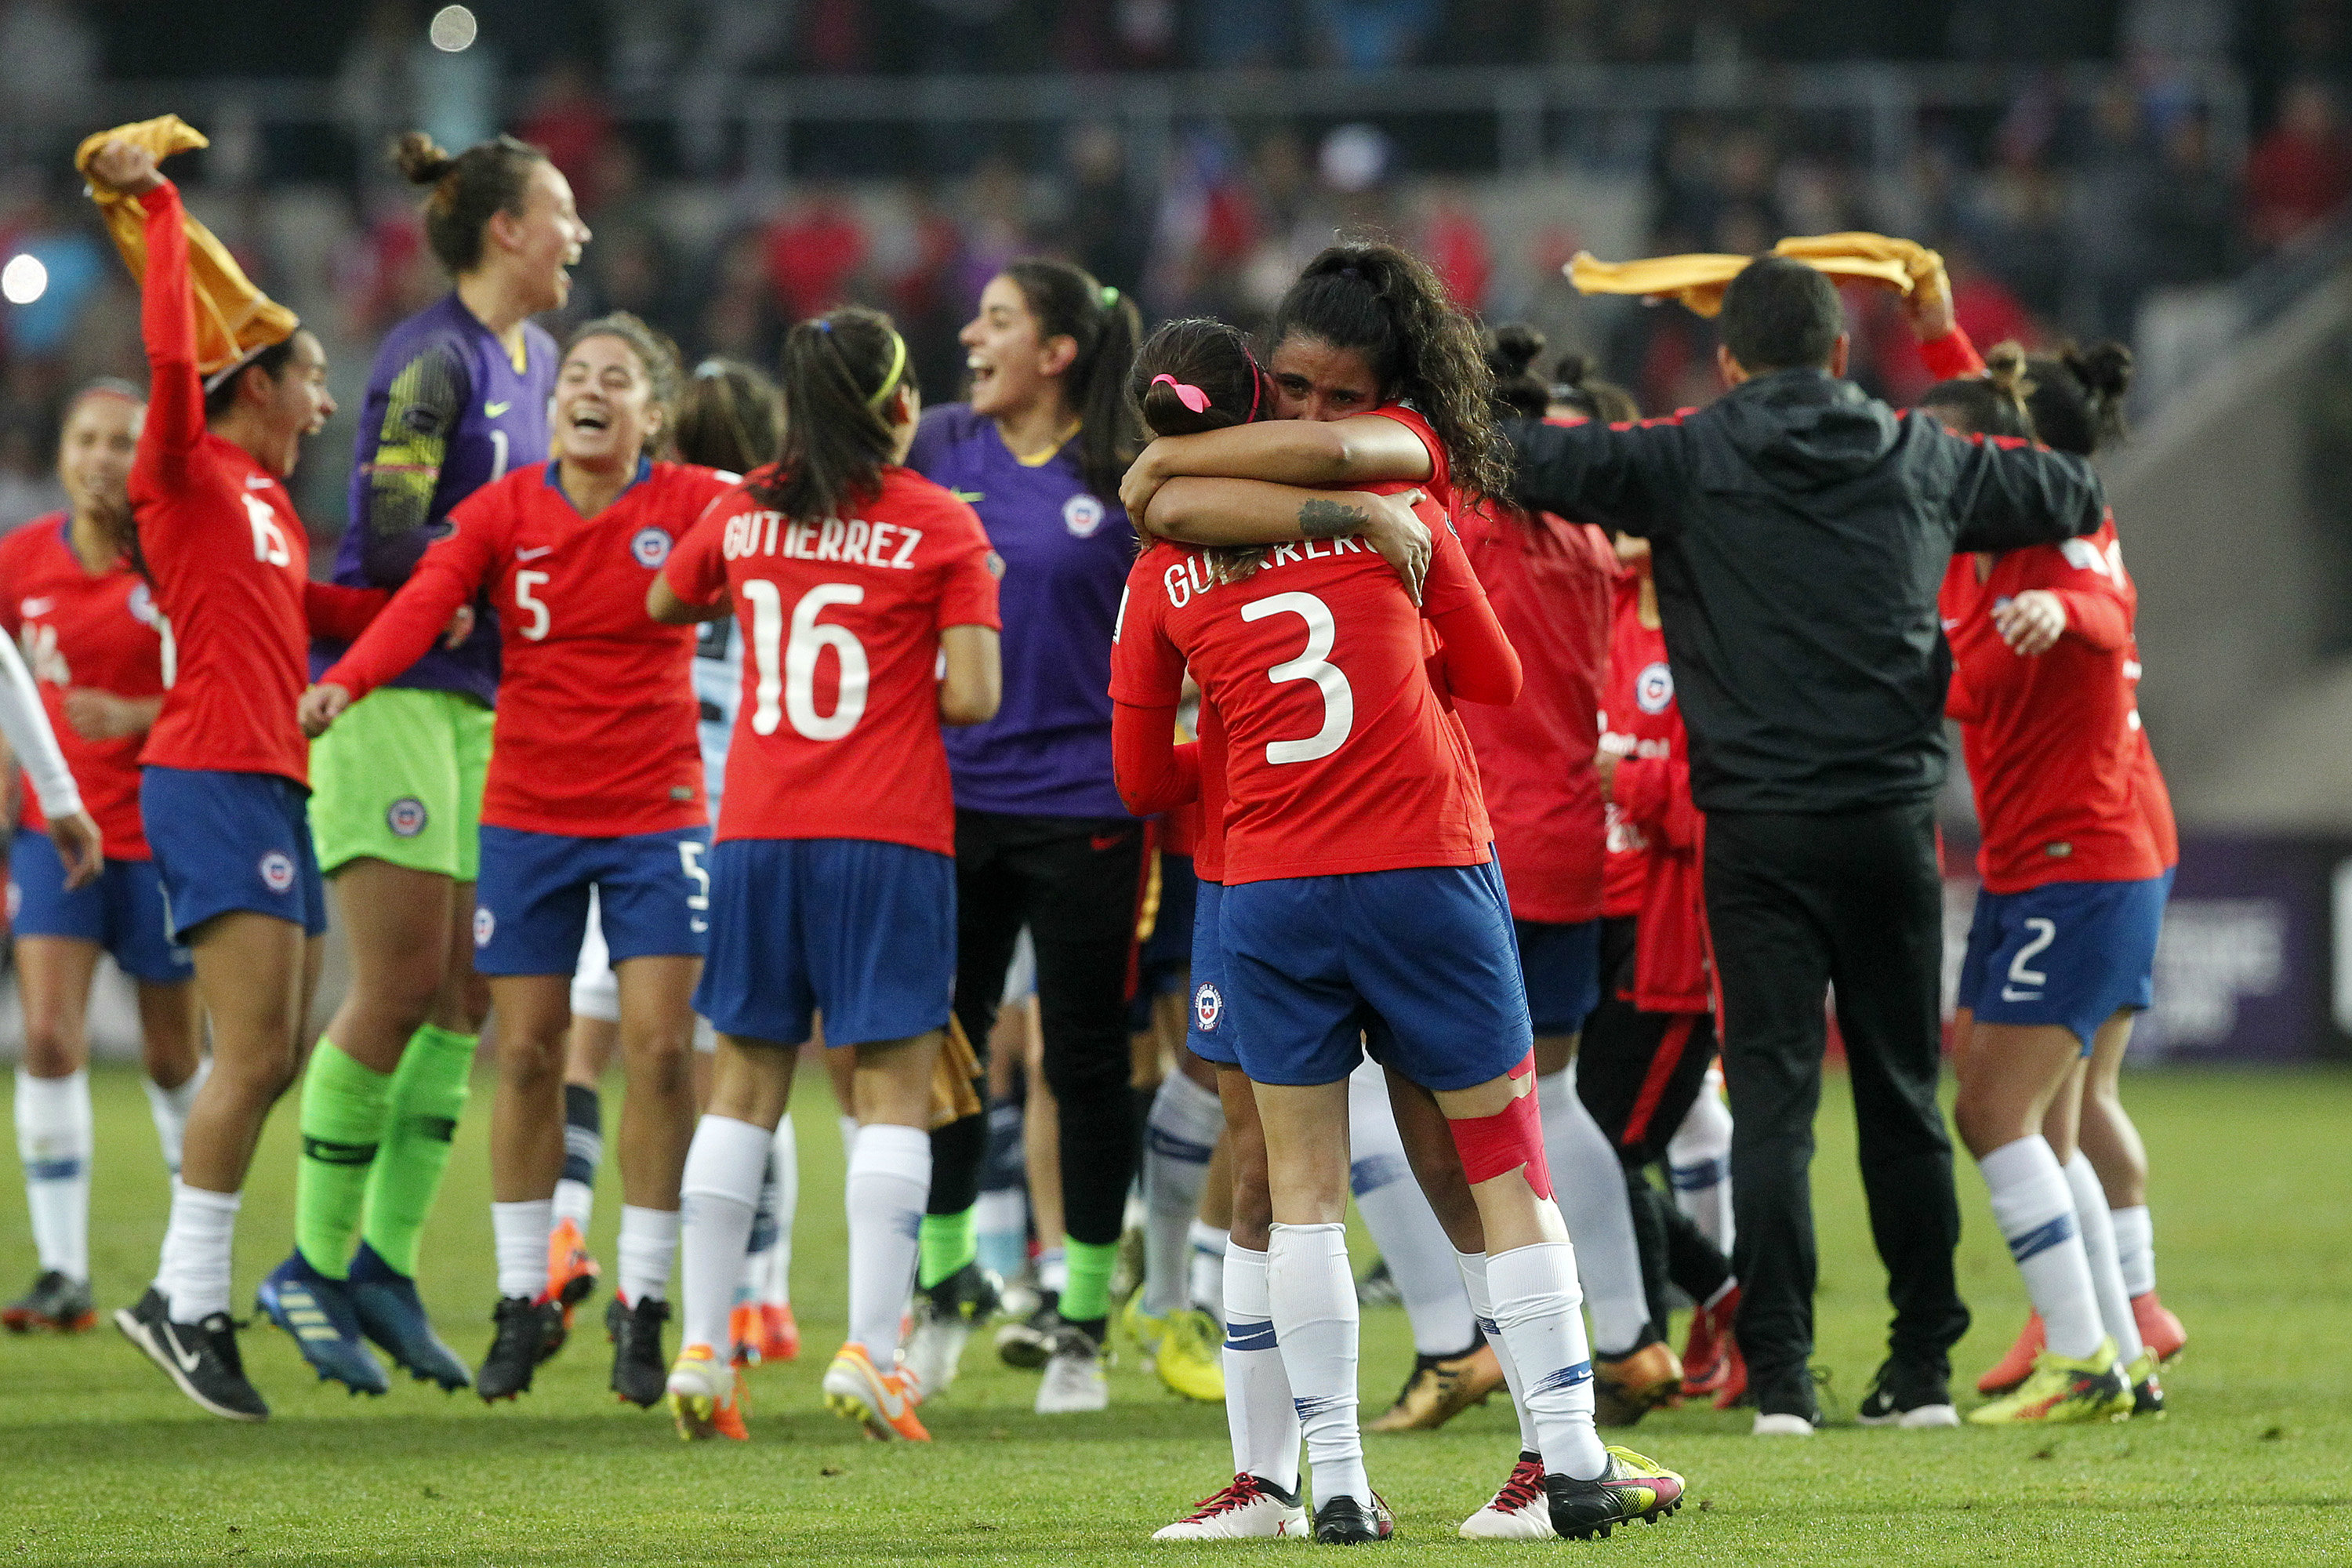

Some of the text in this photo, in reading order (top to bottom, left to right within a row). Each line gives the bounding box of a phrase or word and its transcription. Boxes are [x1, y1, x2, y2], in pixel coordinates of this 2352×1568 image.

[723, 510, 923, 569] GUTIERREZ
[515, 569, 550, 641] 5
[742, 579, 870, 742] 16
[1240, 591, 1354, 765] 3
[678, 840, 710, 911] 5
[2007, 916, 2056, 986] 2
